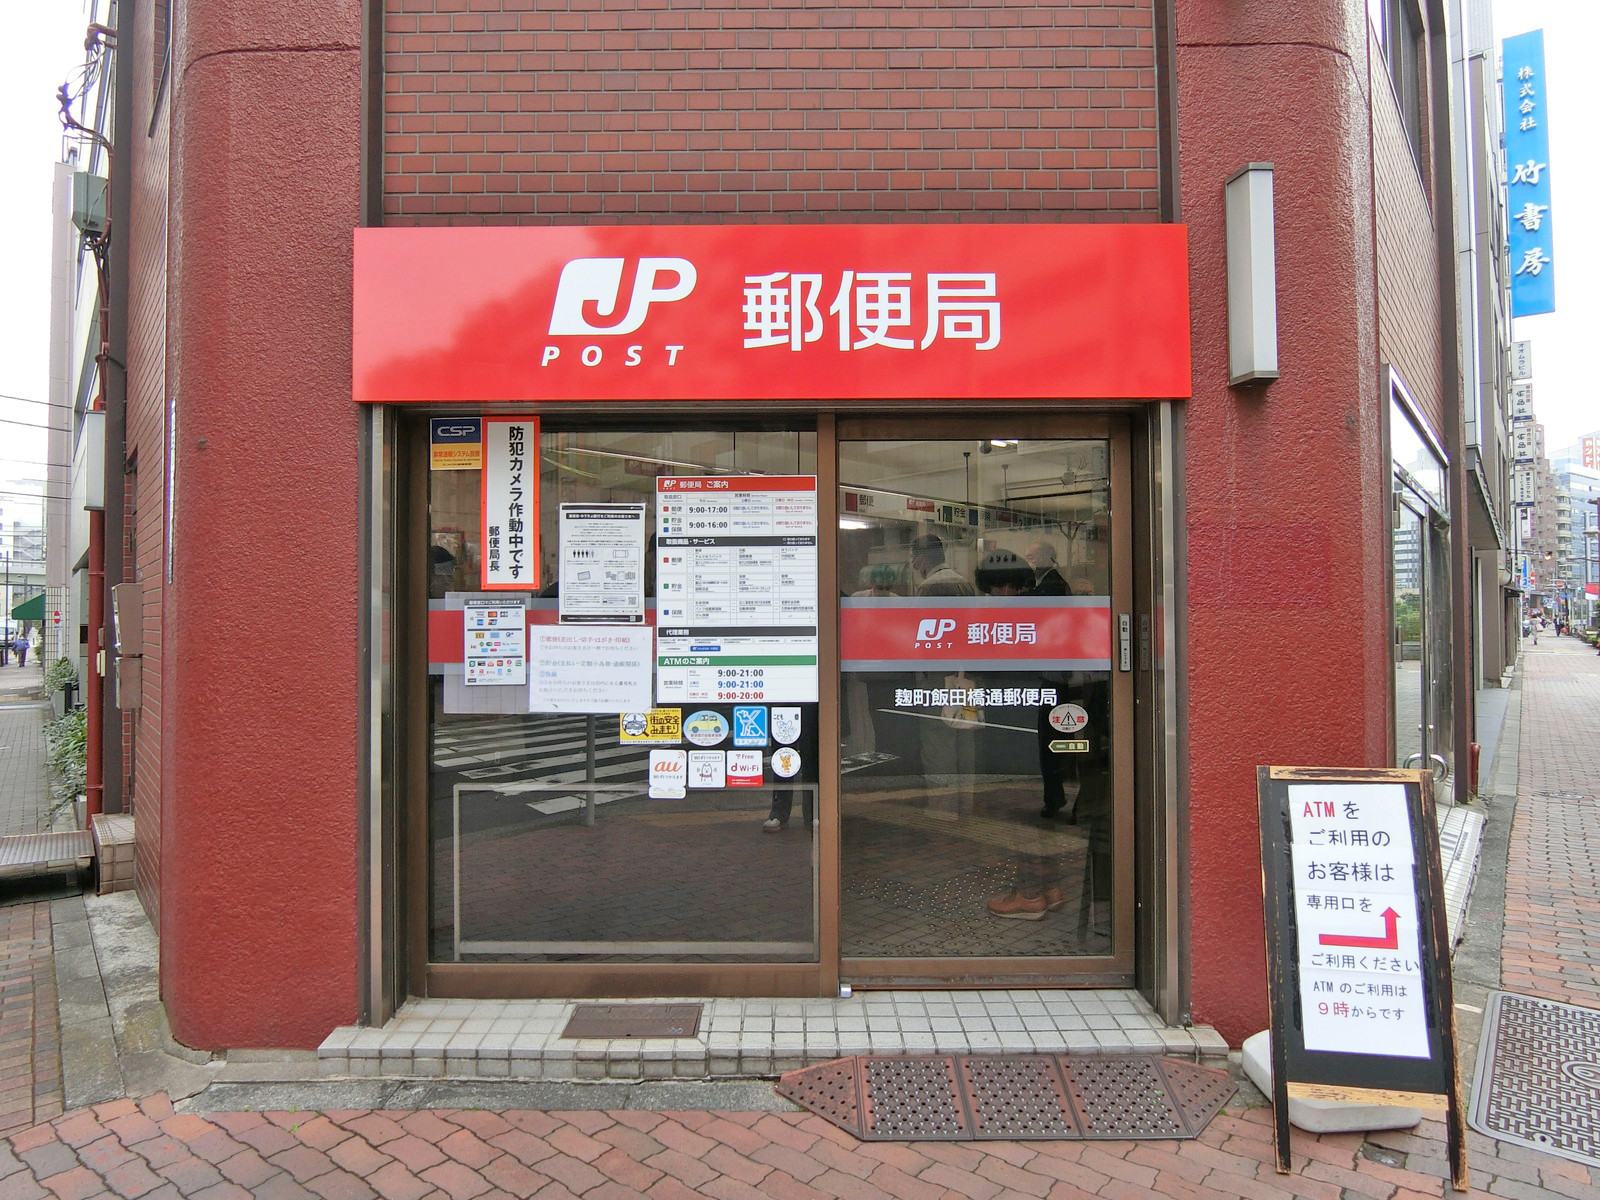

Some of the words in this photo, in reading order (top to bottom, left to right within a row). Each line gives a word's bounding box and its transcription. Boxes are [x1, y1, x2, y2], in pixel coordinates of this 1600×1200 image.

[1516, 65, 1537, 131] 株式会社
[1511, 159, 1551, 277] 竹書房
[548, 257, 698, 336] JP
[741, 270, 1002, 352] 郵便局
[541, 345, 685, 367] POST
[437, 425, 476, 437] CSP
[679, 480, 702, 489] 郵便局
[706, 480, 729, 489] ご案内
[508, 426, 525, 579] 防犯カメラ作動中です
[859, 494, 874, 507] 郵便
[689, 521, 728, 529] 9:00-16:00
[488, 525, 500, 572] 郵便局長
[966, 622, 1038, 646] 郵便局
[717, 669, 764, 677] 9:00-21:00
[717, 680, 764, 688] 9:00-21:00
[717, 692, 764, 700] 9:00-20:00
[894, 687, 1058, 707] 麹町飯田橋通郵便局
[650, 715, 680, 725] 街の安全
[650, 725, 680, 734] みまもり
[654, 760, 683, 773] au
[730, 762, 738, 772] d
[1303, 801, 1336, 818] ATM
[1343, 801, 1361, 820] を
[1308, 829, 1391, 847] ご利用の
[1307, 861, 1395, 882] お客様は
[1306, 894, 1373, 913] 専用口を
[1311, 954, 1421, 973] ご利用ください
[1313, 981, 1335, 994] ATM
[1340, 982, 1408, 997] のご利用は
